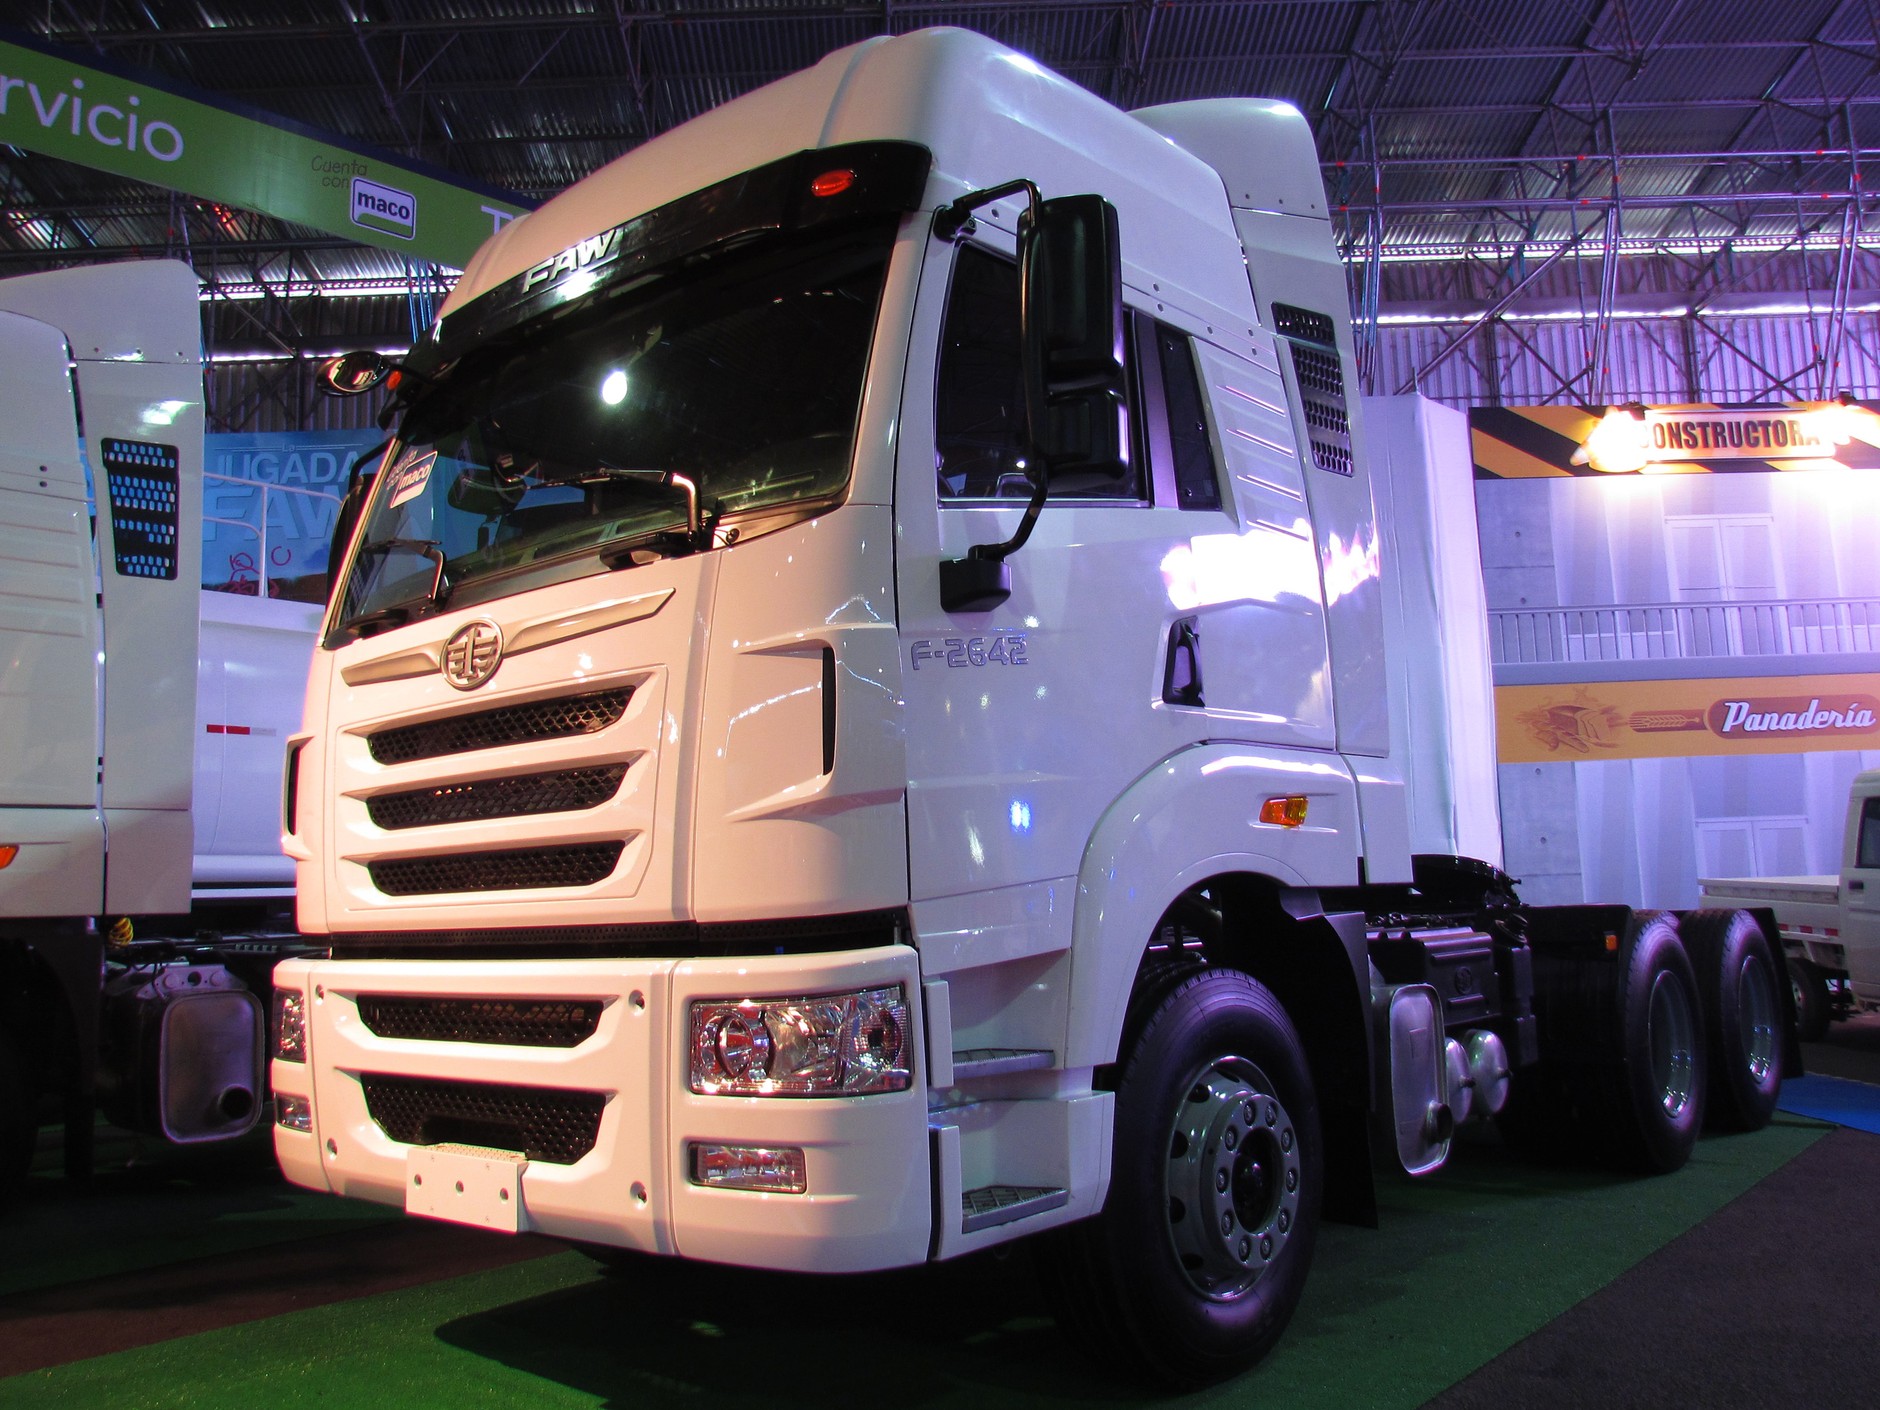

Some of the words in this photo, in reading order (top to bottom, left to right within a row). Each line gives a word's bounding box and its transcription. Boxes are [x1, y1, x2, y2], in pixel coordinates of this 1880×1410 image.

[311, 155, 367, 176] Cuenta
[321, 175, 349, 190] con
[357, 191, 411, 221] maco
[522, 229, 617, 294] FAW
[1639, 419, 1820, 449] ONSTRUCTOR
[398, 464, 430, 490] maco
[911, 637, 1029, 670] F-2642
[1722, 699, 1876, 732] Panadería
